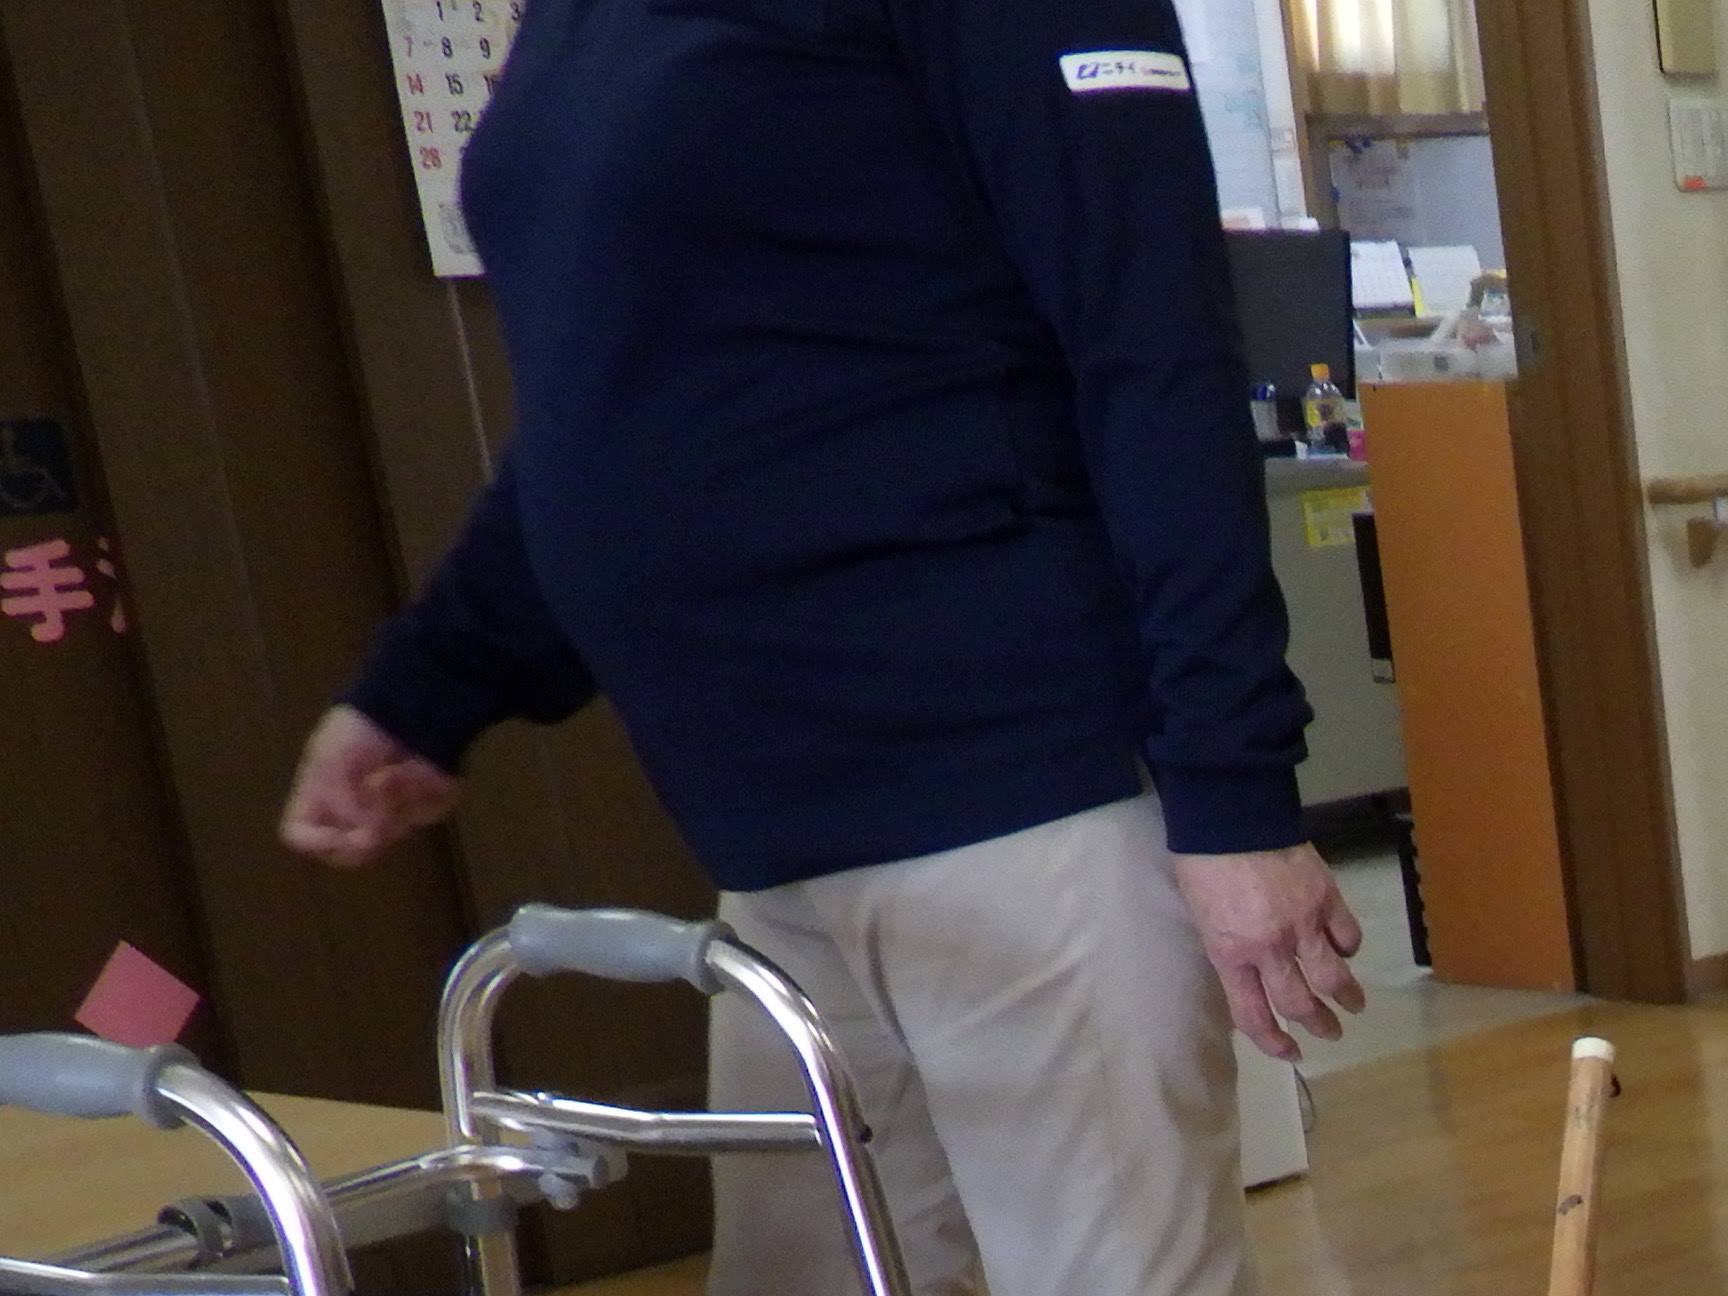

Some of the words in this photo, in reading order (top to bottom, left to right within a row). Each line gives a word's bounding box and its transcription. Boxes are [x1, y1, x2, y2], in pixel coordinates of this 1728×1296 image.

[473, 1, 484, 22] 2
[441, 37, 452, 58] 8
[480, 37, 490, 59] 9
[407, 74, 424, 95] 14
[445, 73, 463, 95] 15
[413, 110, 433, 133] 21
[452, 111, 474, 133] 22
[420, 147, 442, 170] 28
